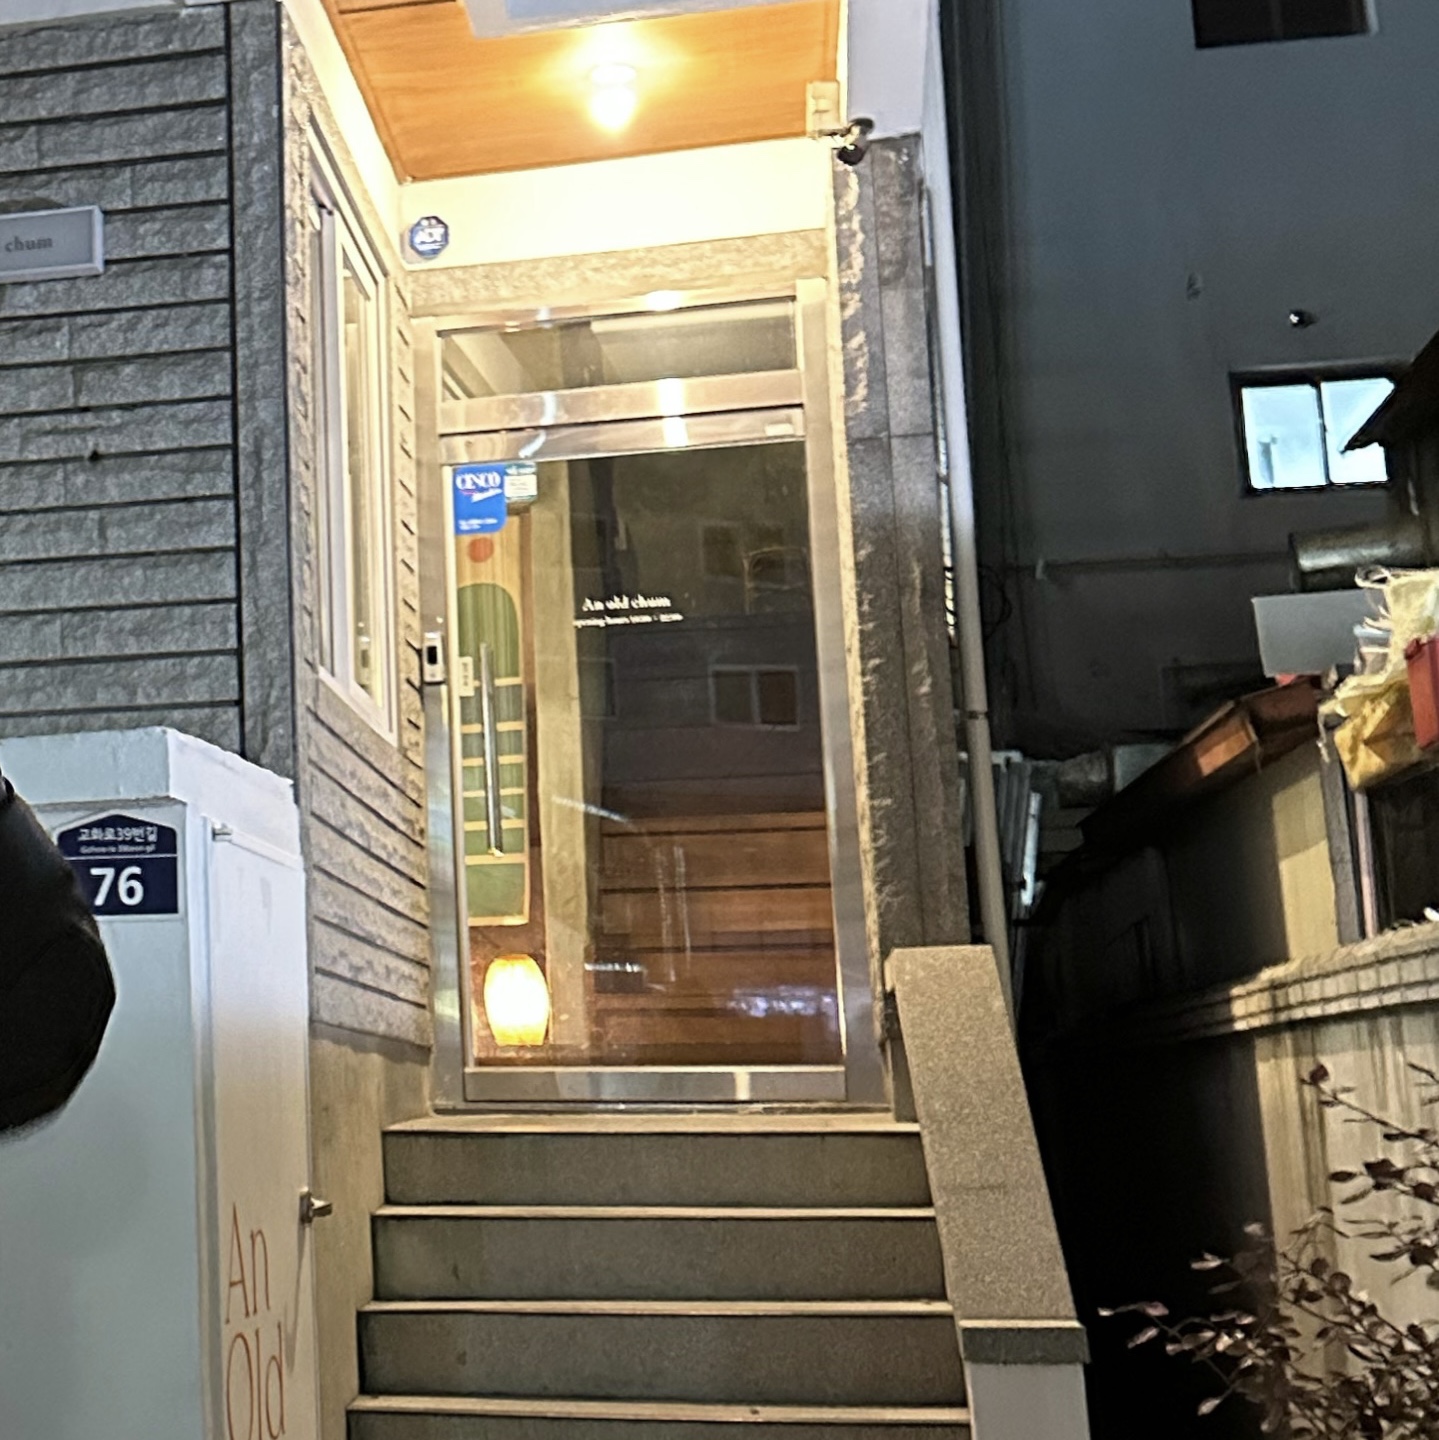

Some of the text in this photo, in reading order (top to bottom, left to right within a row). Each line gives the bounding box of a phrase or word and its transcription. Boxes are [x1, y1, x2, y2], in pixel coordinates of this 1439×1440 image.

[4, 235, 53, 254] chum
[582, 594, 671, 611] An old chum
[90, 866, 144, 906] 76
[224, 1202, 271, 1325] An
